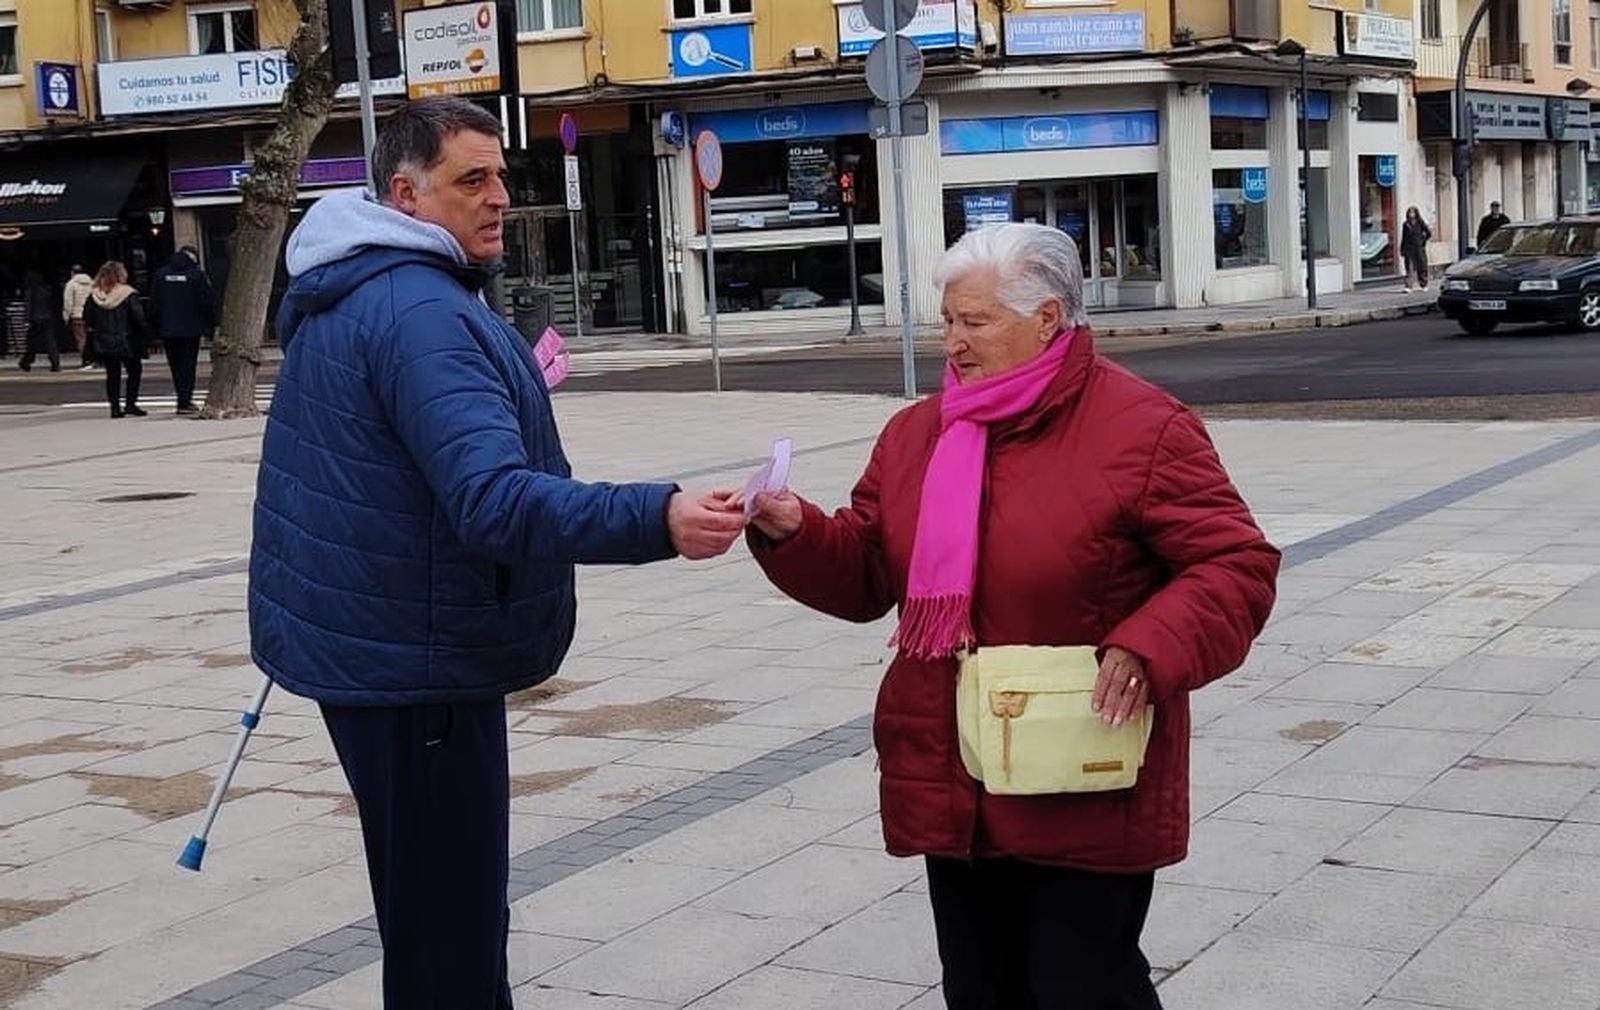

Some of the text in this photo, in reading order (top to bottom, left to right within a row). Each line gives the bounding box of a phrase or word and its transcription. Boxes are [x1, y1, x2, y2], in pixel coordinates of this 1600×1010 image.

[414, 18, 478, 41] codisol
[1010, 20, 1038, 42] juan
[423, 60, 462, 73] REPSOL
[119, 70, 221, 90] Cuidamos tu salud
[764, 115, 798, 132] beds
[1030, 125, 1064, 141] beds
